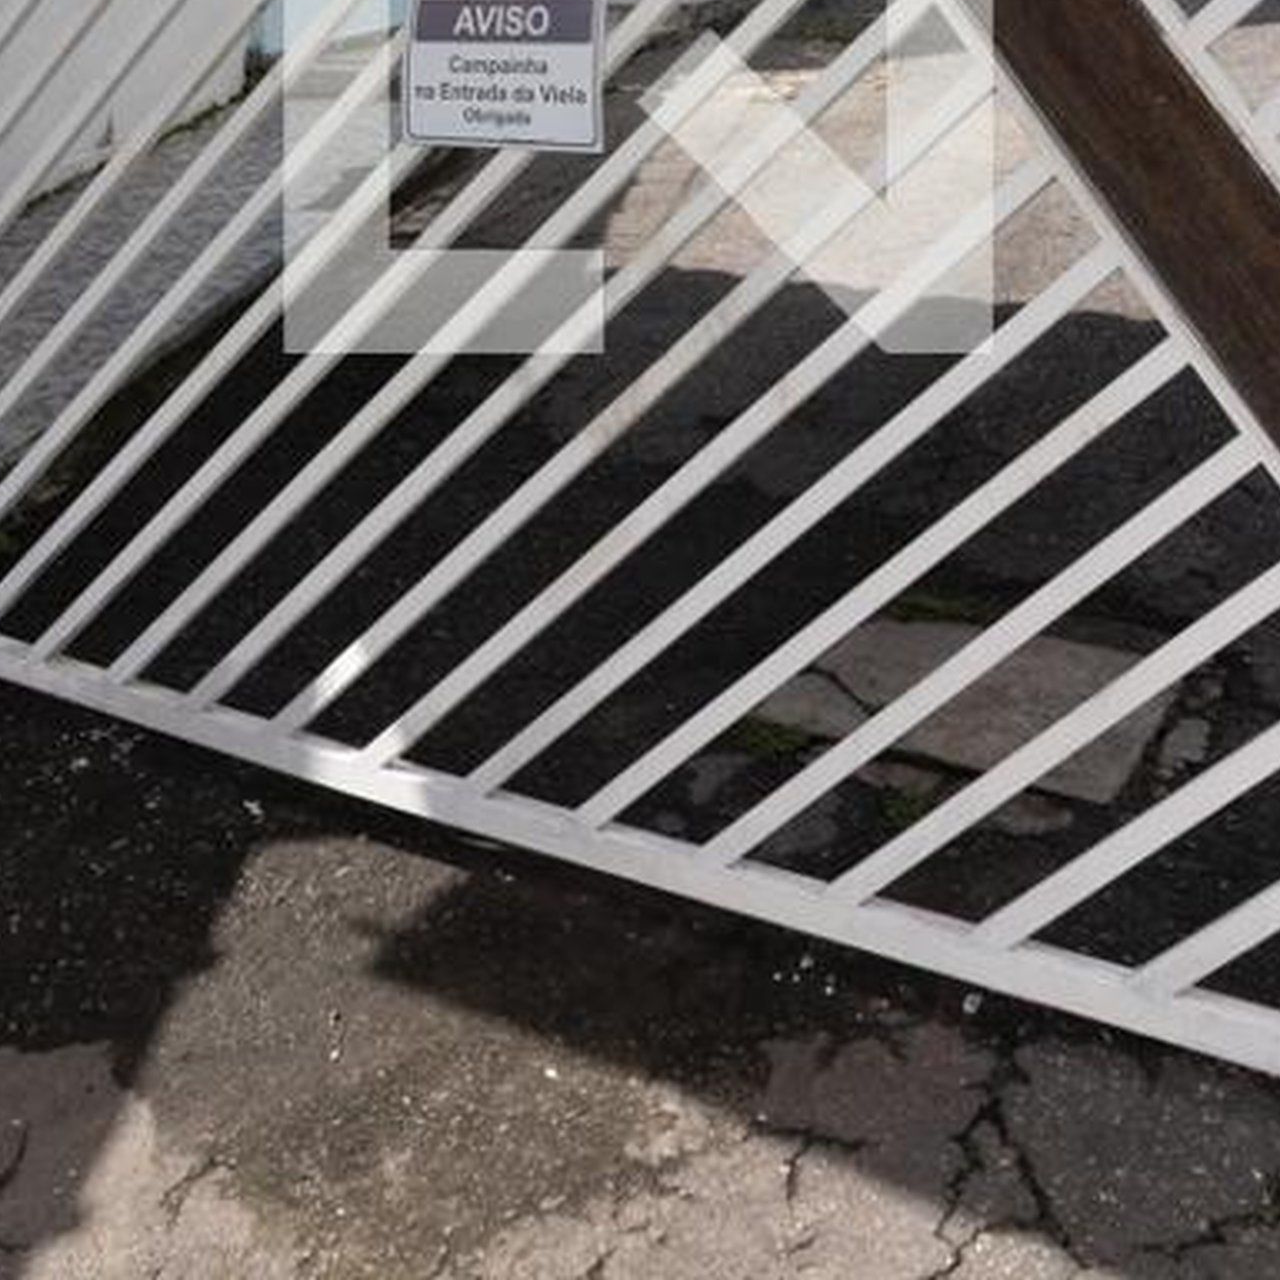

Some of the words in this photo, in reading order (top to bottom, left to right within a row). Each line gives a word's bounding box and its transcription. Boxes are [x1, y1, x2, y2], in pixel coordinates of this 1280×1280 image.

[453, 5, 550, 37] AVISO
[449, 54, 548, 76] Campainha
[414, 85, 435, 101] na
[439, 83, 507, 101] Entrada
[511, 87, 534, 103] da
[539, 85, 588, 104] Viela
